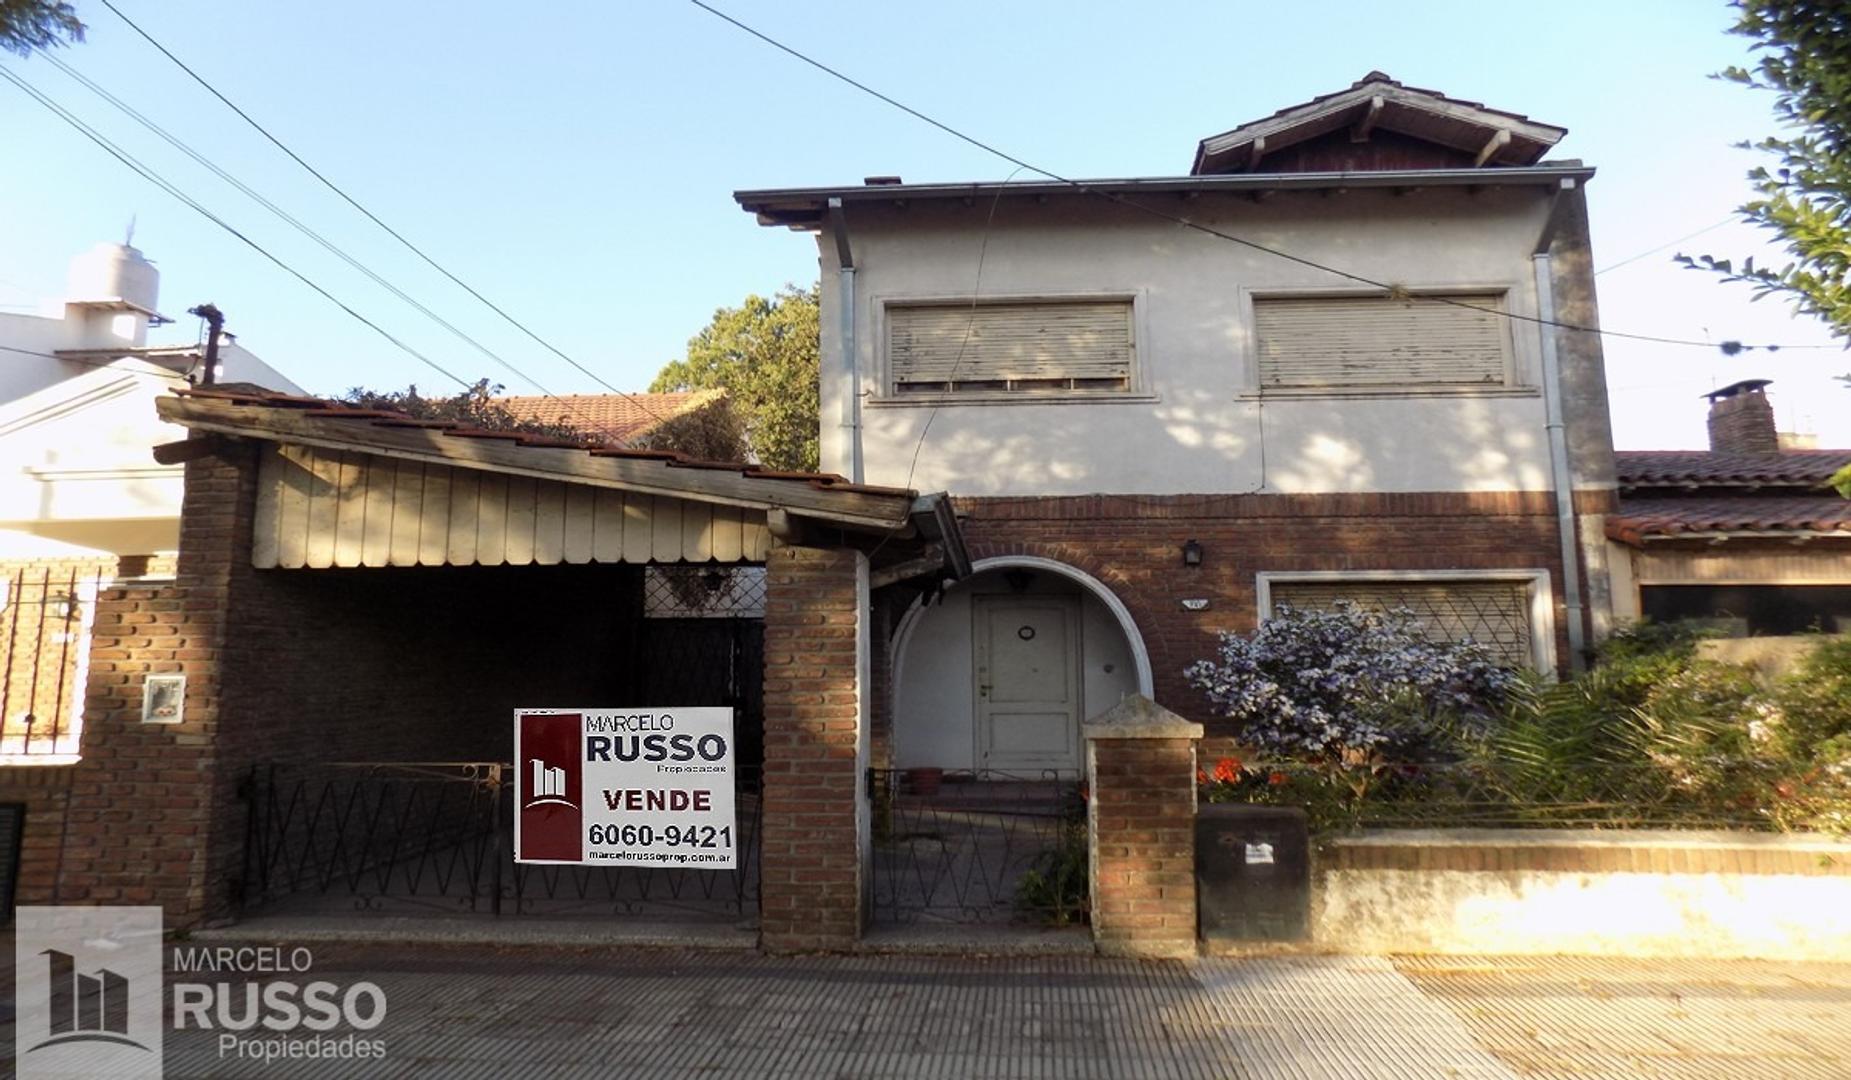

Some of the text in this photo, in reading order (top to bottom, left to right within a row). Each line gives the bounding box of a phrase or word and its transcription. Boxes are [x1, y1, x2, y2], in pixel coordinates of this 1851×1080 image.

[586, 714, 674, 732] MARCELO
[586, 734, 727, 762] RUSSO
[603, 789, 712, 811] VENDE
[588, 824, 732, 848] 6060-9421
[589, 850, 731, 863] marcelorussoprop.com.ar
